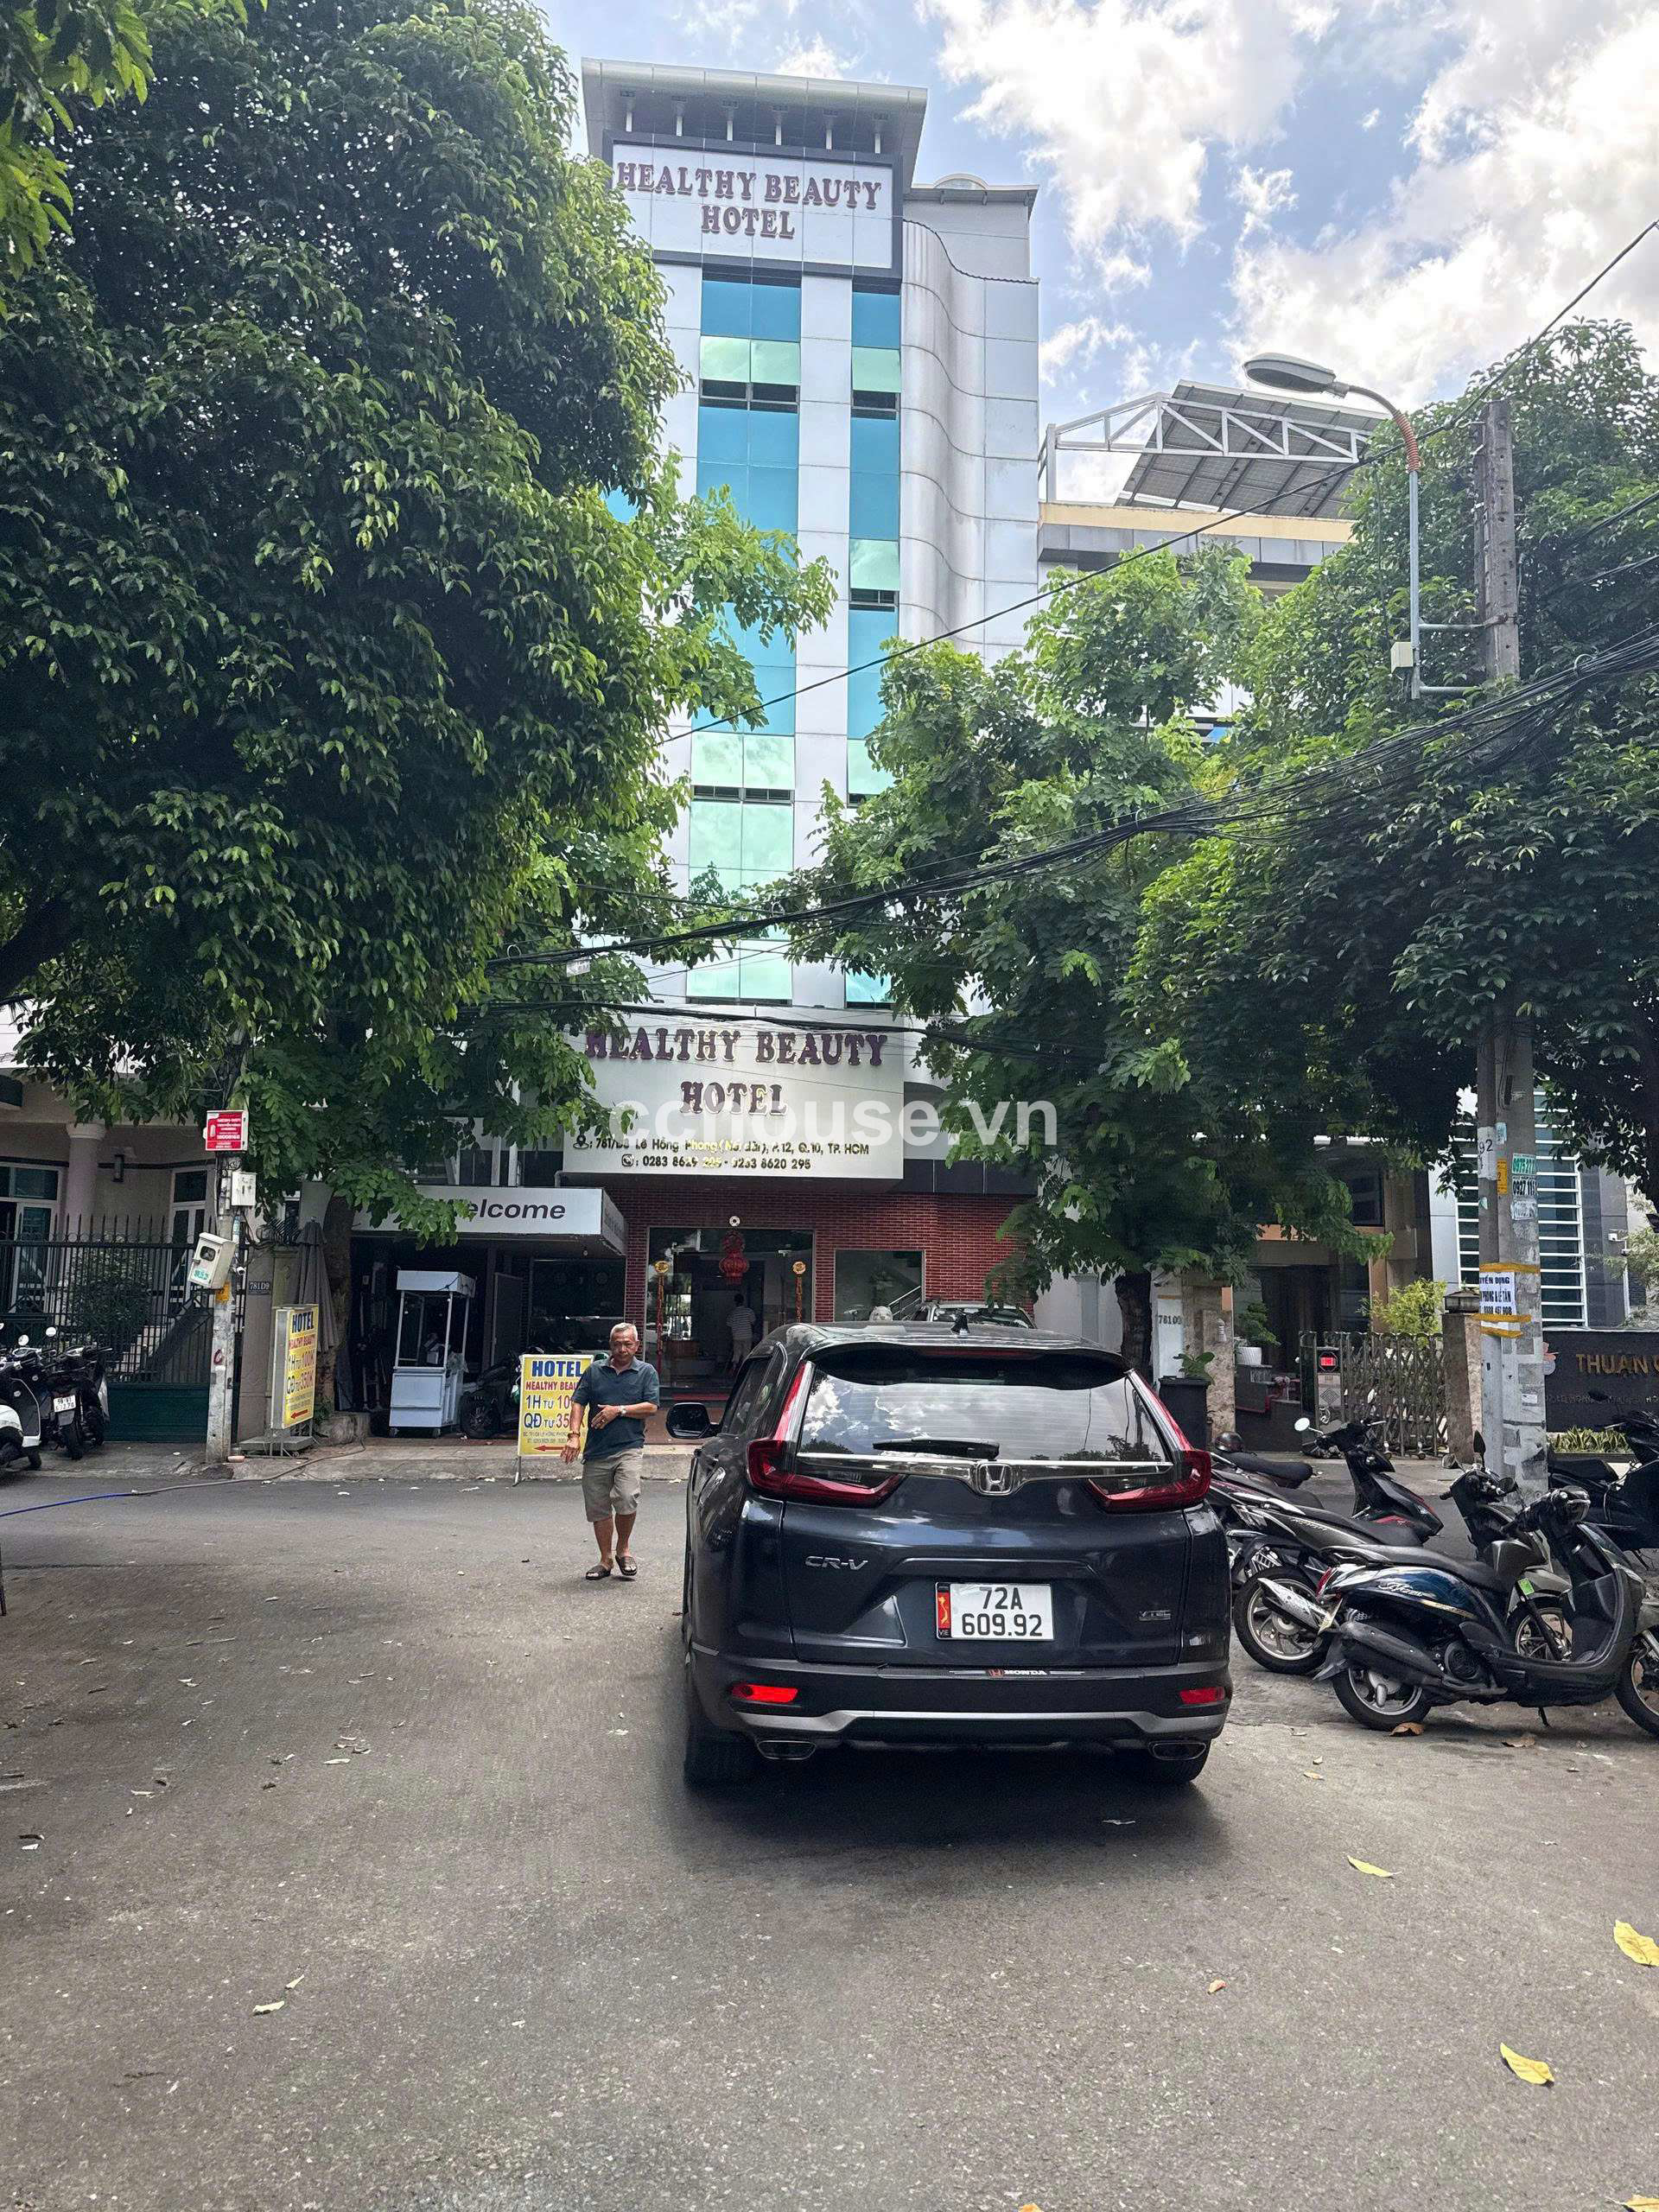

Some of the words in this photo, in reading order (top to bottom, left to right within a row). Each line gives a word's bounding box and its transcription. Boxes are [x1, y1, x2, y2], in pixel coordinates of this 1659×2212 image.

[617, 162, 757, 200] HEALTHY
[764, 174, 882, 210] BEAUTY
[701, 205, 796, 239] HOTEL
[584, 1026, 741, 1062] HEALTHY
[755, 1030, 888, 1066] BEAUTY
[678, 1081, 788, 1116] HOTEL
[844, 1143, 869, 1155] HCM
[642, 1154, 668, 1166] 0283
[791, 1159, 811, 1169] 295
[439, 1198, 566, 1219] elcome
[292, 1311, 314, 1333] HOTEL
[531, 1360, 582, 1377] HOTEL
[526, 1395, 541, 1409] 1H
[524, 1413, 542, 1428] QĐ
[805, 1555, 868, 1571] CR-V
[979, 1586, 1023, 1610] 72A
[962, 1613, 1043, 1637] 609.92
